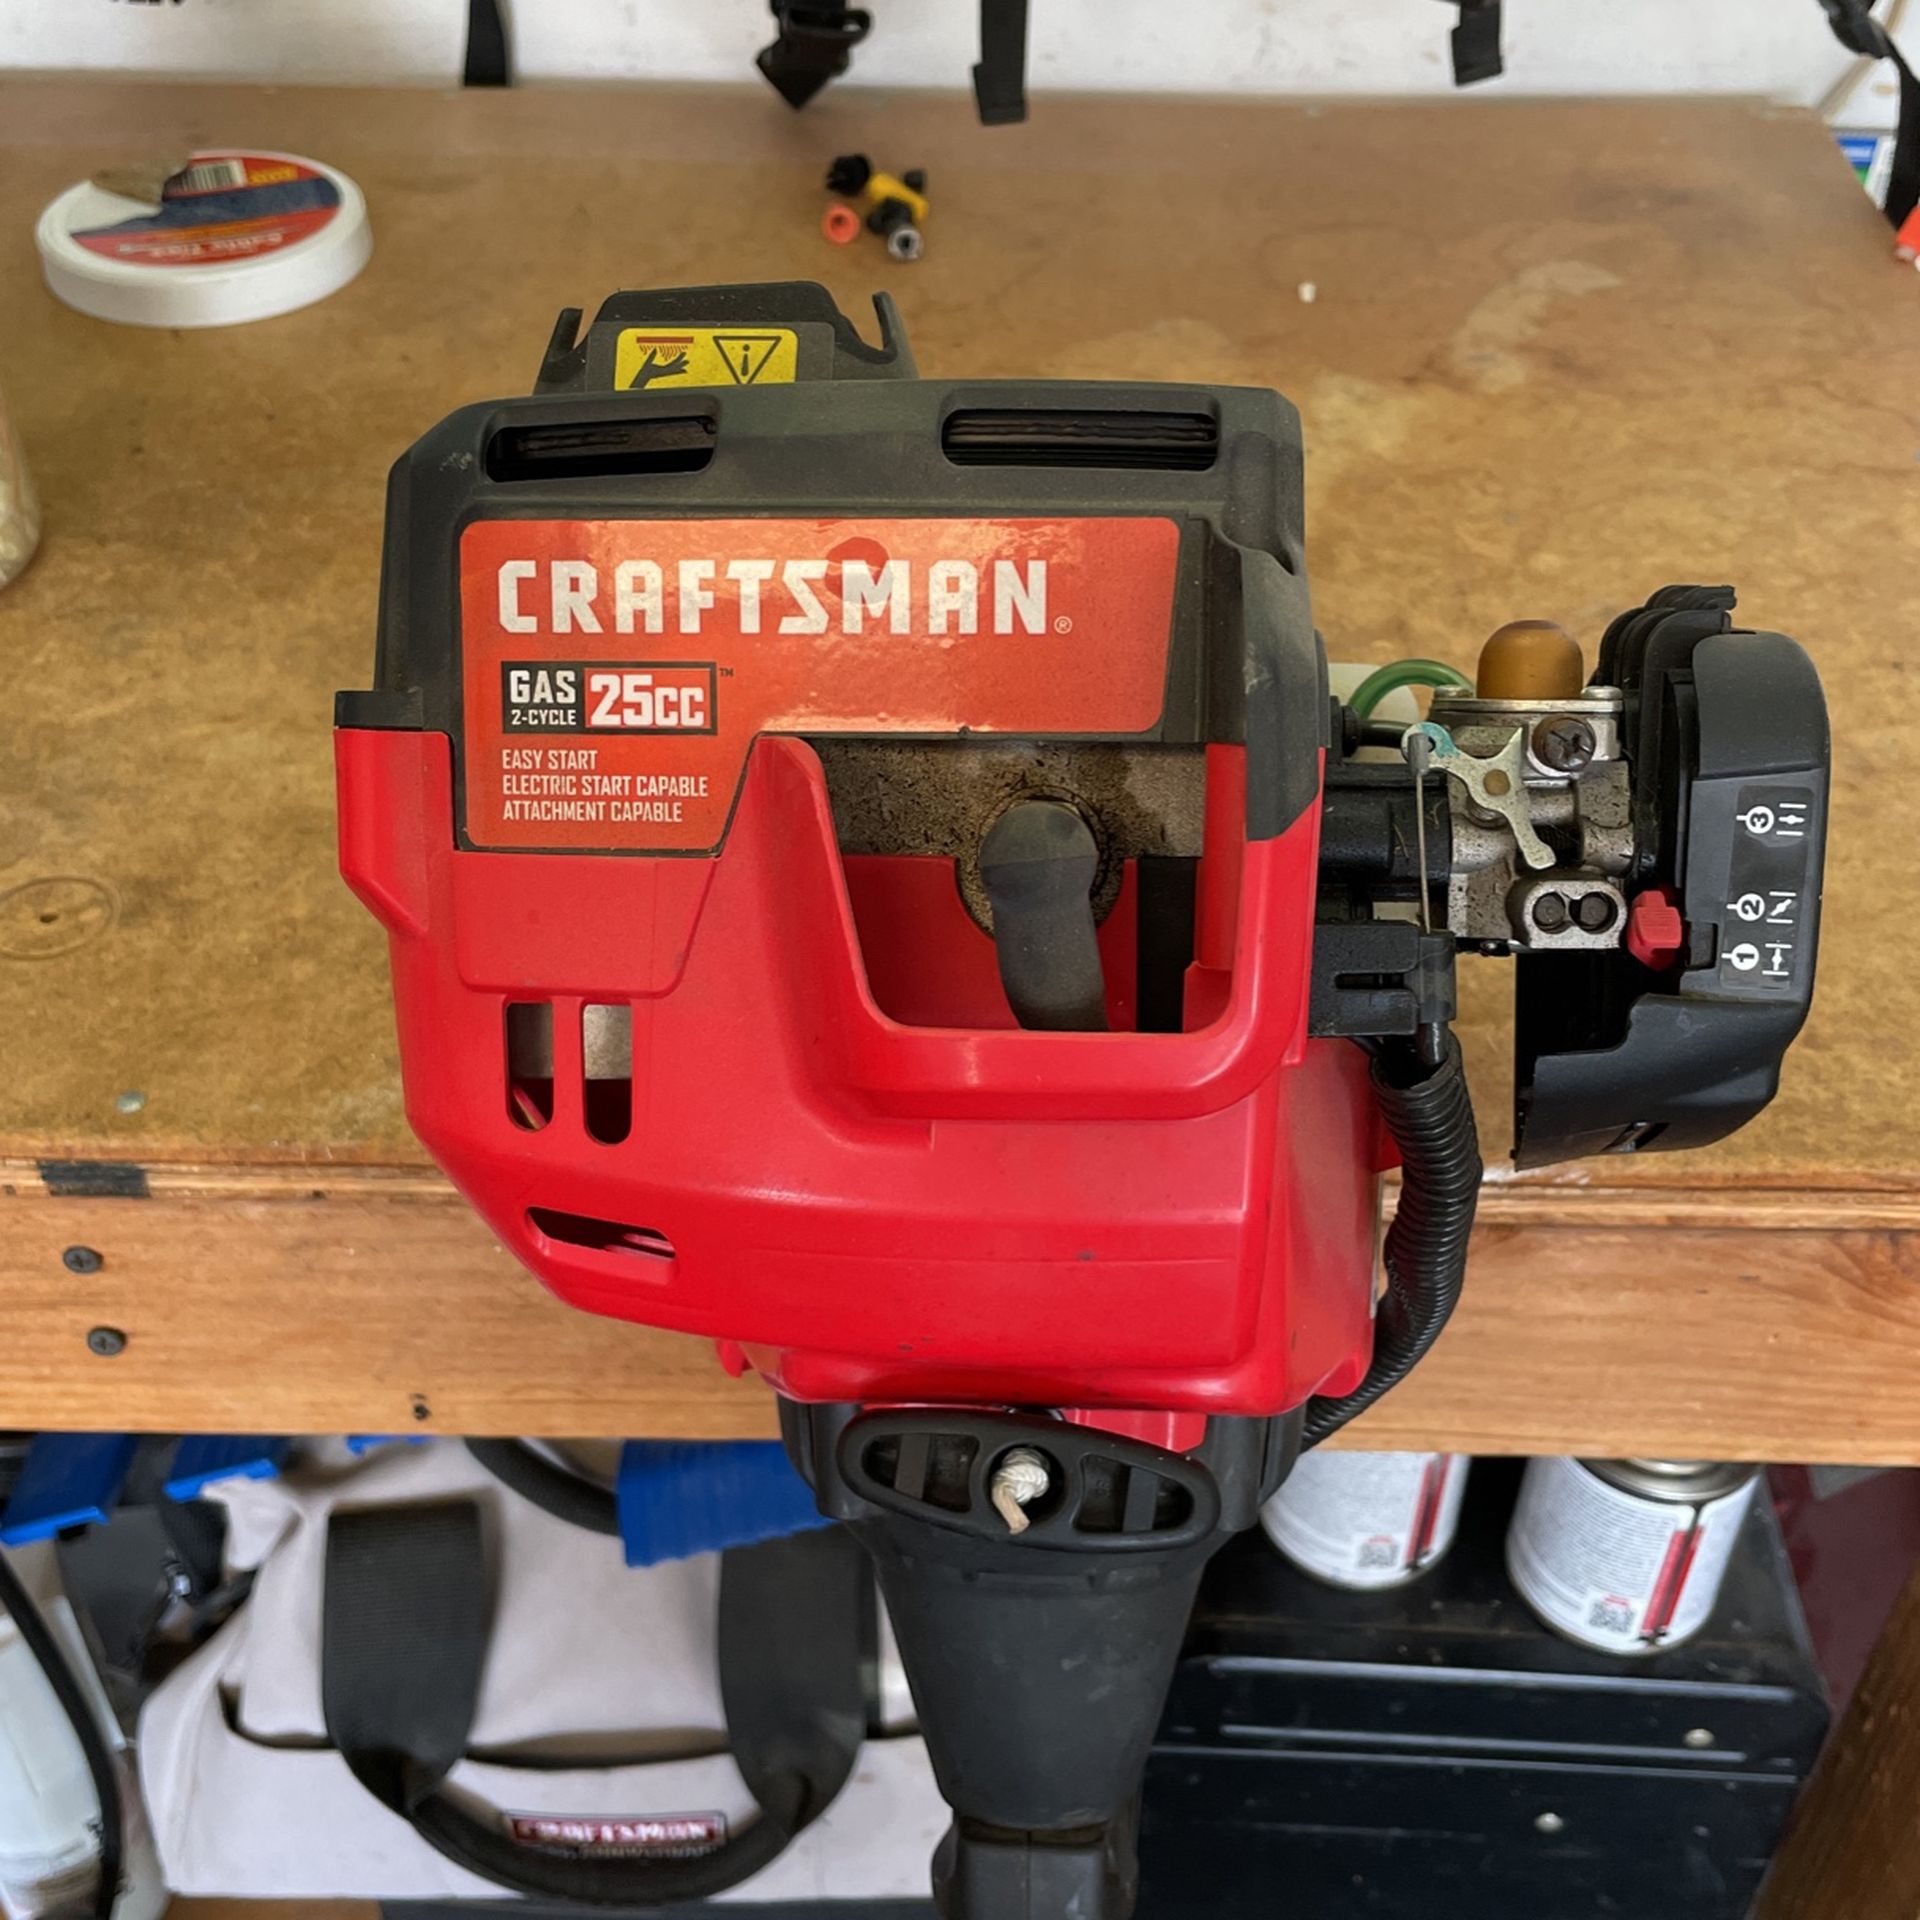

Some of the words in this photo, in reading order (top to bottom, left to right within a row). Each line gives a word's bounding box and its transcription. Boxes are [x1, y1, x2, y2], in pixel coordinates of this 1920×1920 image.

[498, 559, 1047, 635] CRAFTSMAN
[509, 669, 576, 704] GAS
[511, 708, 577, 726] 2-CYCLE
[502, 749, 542, 770] EASY
[548, 749, 598, 770] START
[502, 774, 577, 796] ELECTRIC
[581, 775, 632, 797] START
[636, 776, 709, 797] CAPABLE
[502, 799, 606, 821] ATTACHMENT
[610, 801, 683, 823] CAPABLE
